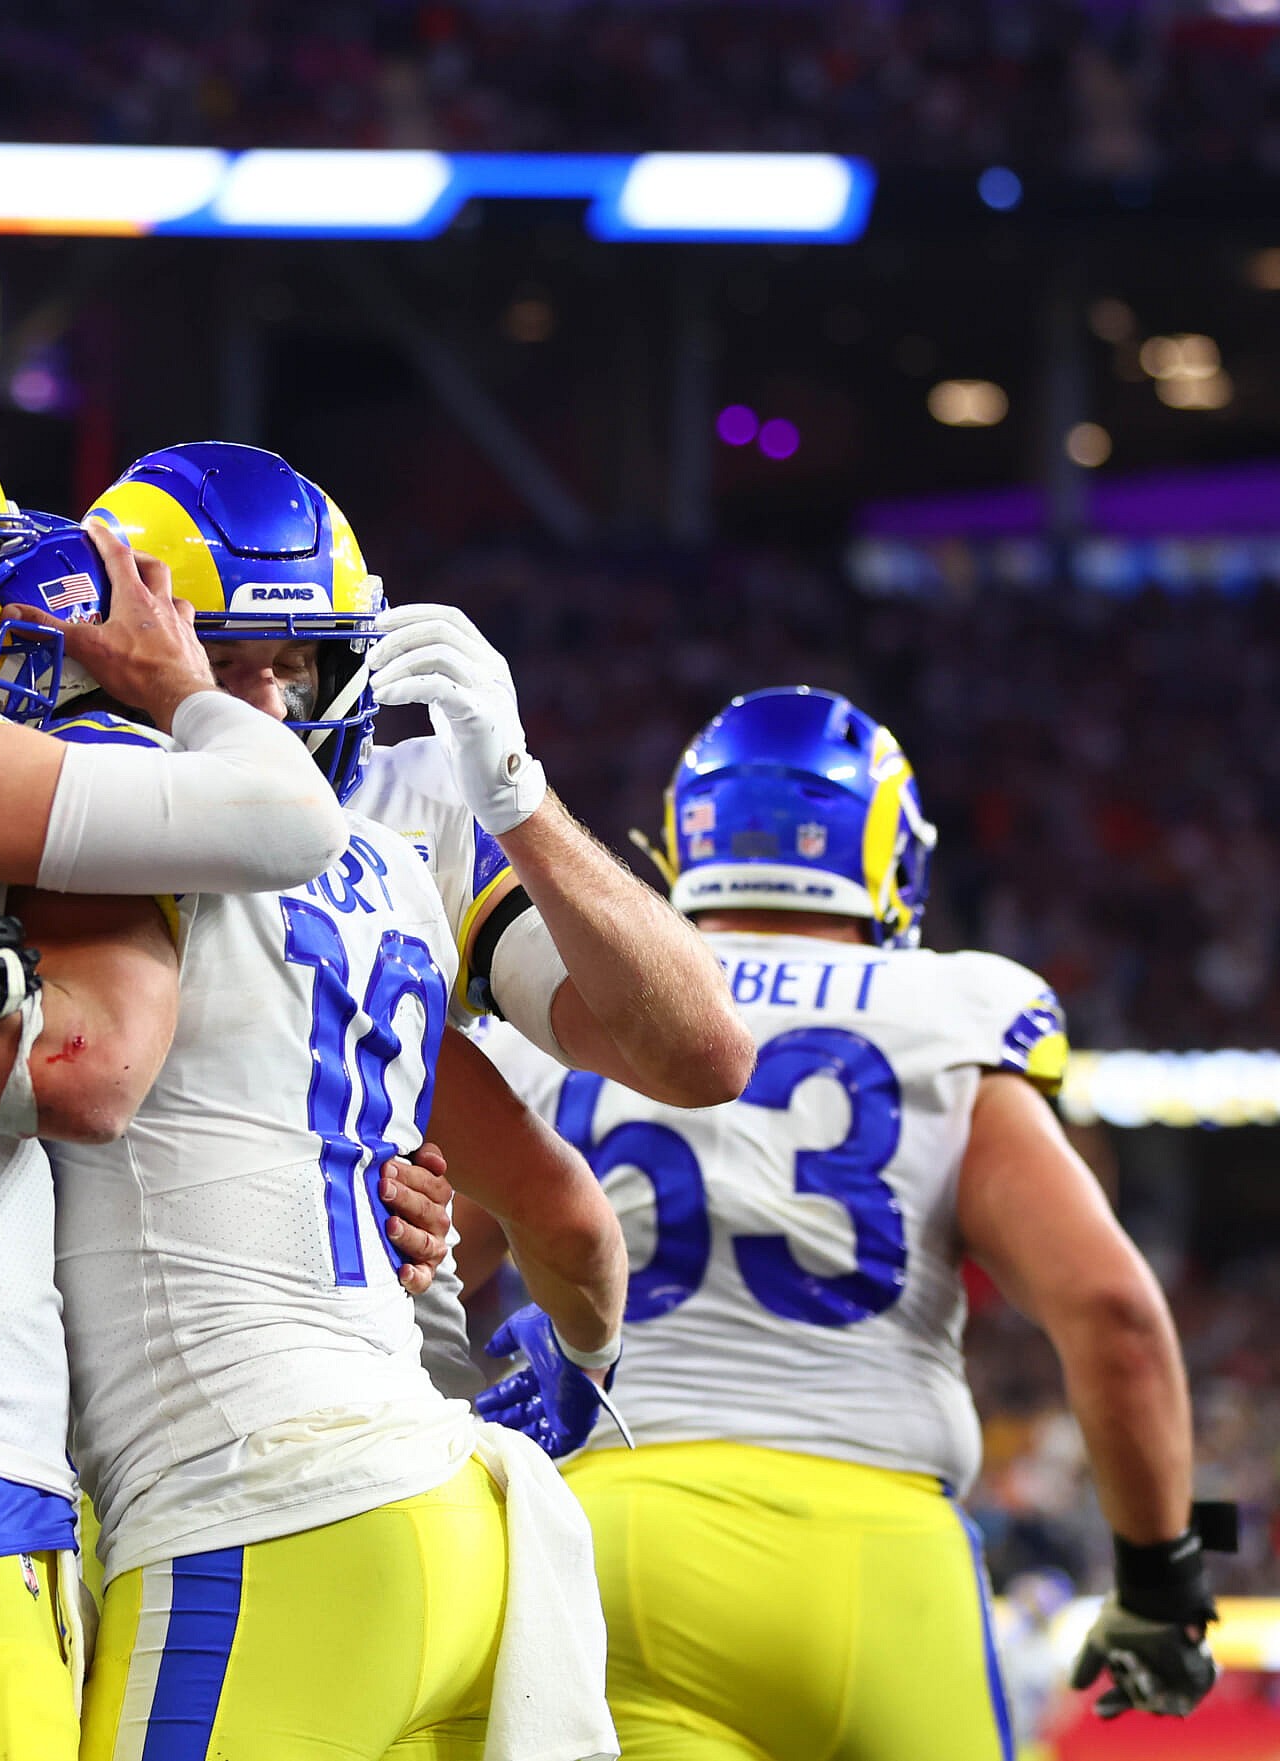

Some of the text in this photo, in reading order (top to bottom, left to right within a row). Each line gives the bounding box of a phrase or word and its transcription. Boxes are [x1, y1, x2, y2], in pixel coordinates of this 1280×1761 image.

[251, 588, 314, 600] RAMS
[721, 959, 888, 1011] BETT
[279, 896, 448, 1288] 10
